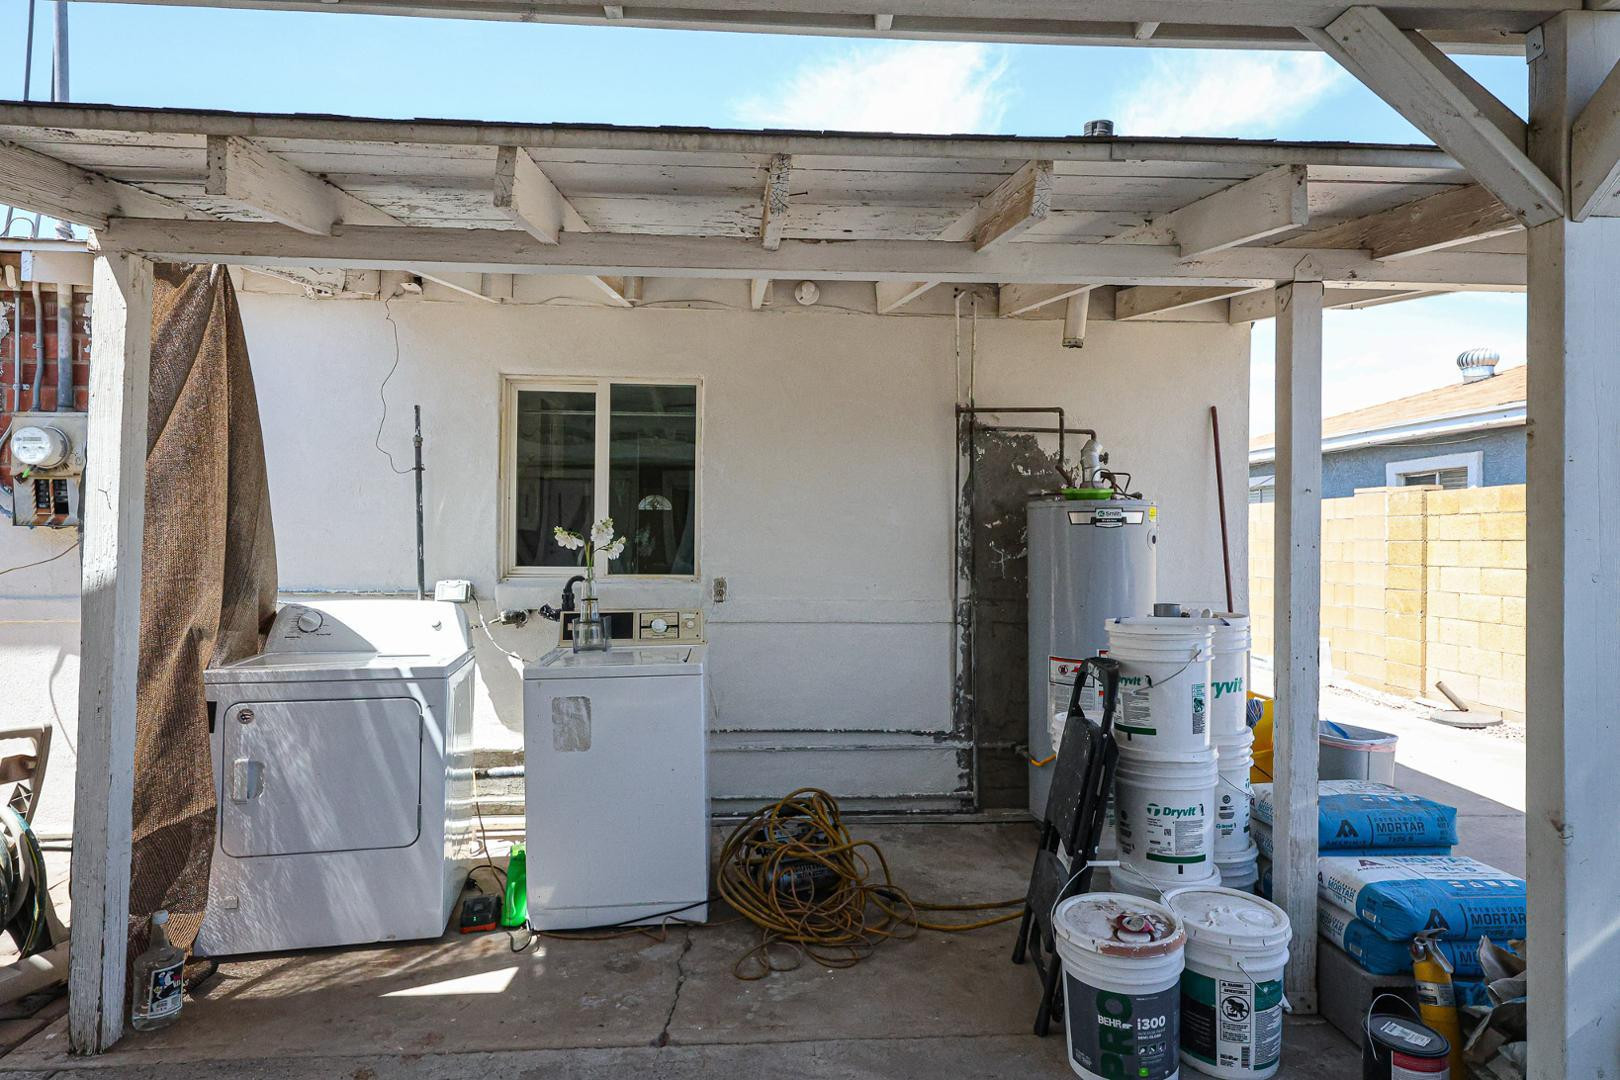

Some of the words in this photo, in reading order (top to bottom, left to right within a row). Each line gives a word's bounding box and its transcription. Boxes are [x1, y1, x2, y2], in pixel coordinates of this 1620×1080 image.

[1162, 806, 1197, 820] Dryvit
[1376, 821, 1425, 833] MORTAR
[1327, 879, 1355, 900] MORTAR
[1471, 912, 1526, 926] MORTAR
[1097, 1014, 1122, 1029] BEHR
[1137, 1015, 1166, 1031] i300
